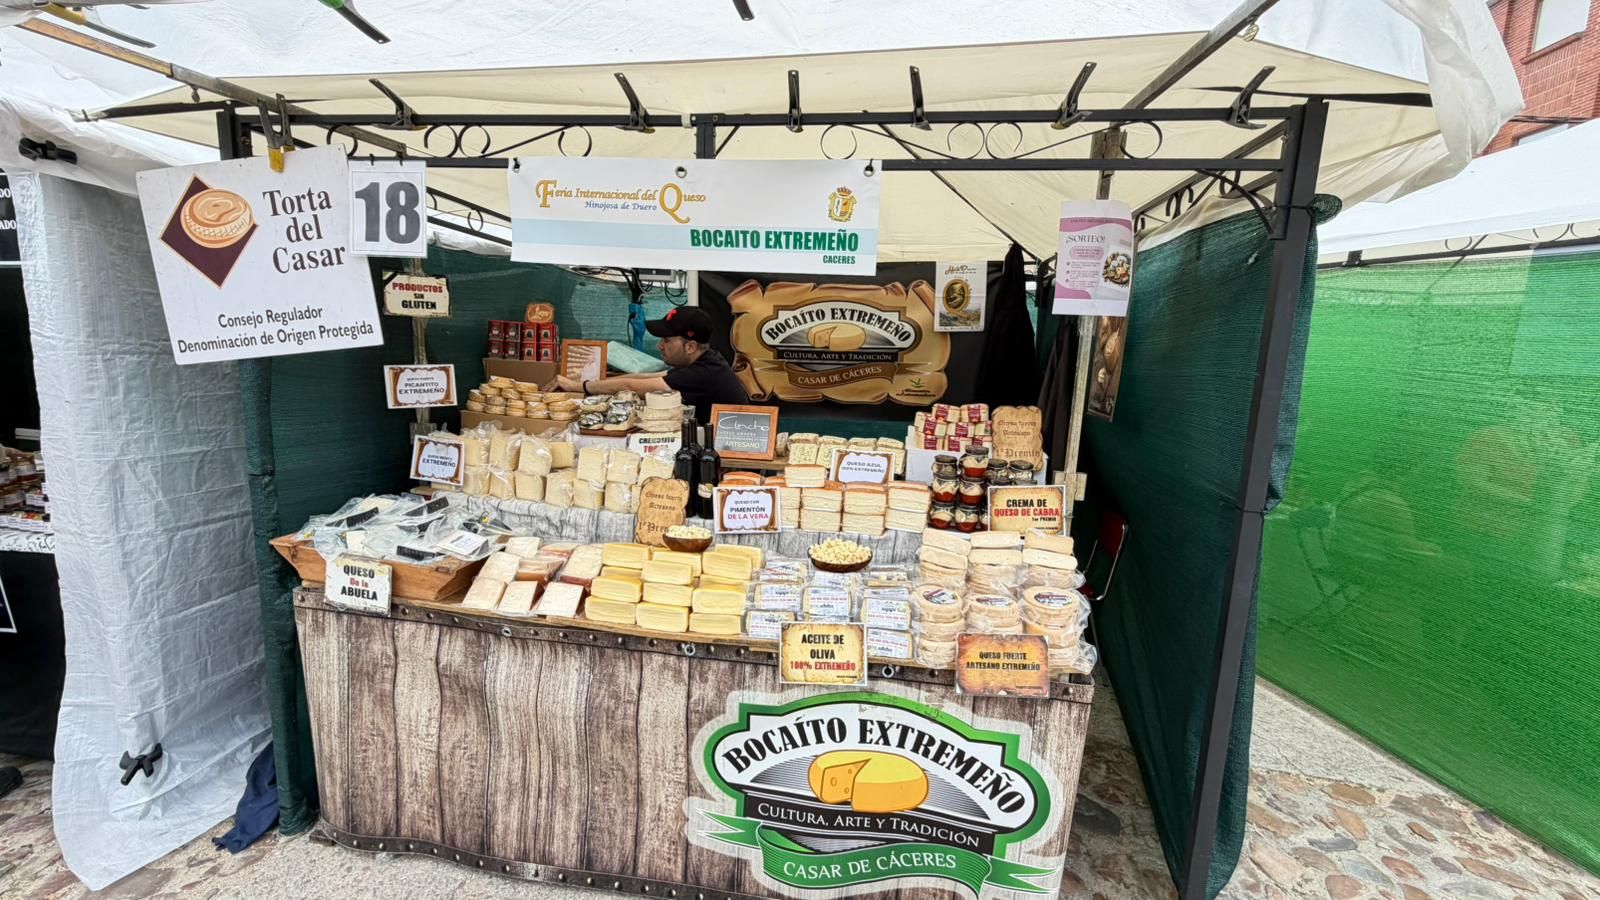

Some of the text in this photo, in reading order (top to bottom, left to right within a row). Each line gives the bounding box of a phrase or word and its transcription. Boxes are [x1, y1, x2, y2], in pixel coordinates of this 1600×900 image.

[263, 187, 332, 217] Torta
[535, 179, 706, 224] Feria Internacional del Queso
[584, 200, 657, 211] Hinojosa de Duero
[355, 181, 420, 245] 18
[286, 214, 323, 243] del
[690, 229, 859, 252] BOCAITO EXTREMEÑO
[272, 244, 346, 274] Casar
[823, 255, 856, 265] CACERES
[392, 282, 443, 293] PRODUCTOS
[401, 300, 437, 310] GLUTEN
[218, 305, 323, 329] Consejo Regulador
[765, 307, 912, 342] BOCAÍTO EXTREMEÑO
[177, 321, 374, 354] Denominación de Origen Protegida
[798, 366, 882, 385] CASAR DE CÁCERES
[730, 505, 766, 513] PIMENTÓN
[1006, 499, 1047, 508] CREMA DE
[994, 508, 1060, 517] QUESO DE CABRA
[343, 565, 375, 579] QUESO
[341, 586, 378, 601] ABUELA
[801, 634, 845, 644] ACEITE DE
[810, 649, 836, 659] OLIVA
[979, 652, 1027, 660] QUESO FUERTE
[790, 660, 856, 671] 100% EXTREMEÑO
[966, 661, 1040, 670] ARTESANO EXTREMEÑO
[722, 715, 1026, 814] BOCAÍTO EXTREMEÑO
[835, 815, 871, 829] ARTE
[875, 819, 885, 828] Y
[892, 819, 980, 848] TRADICIÓN
[783, 850, 957, 880] CASAR DE CÁCERES
